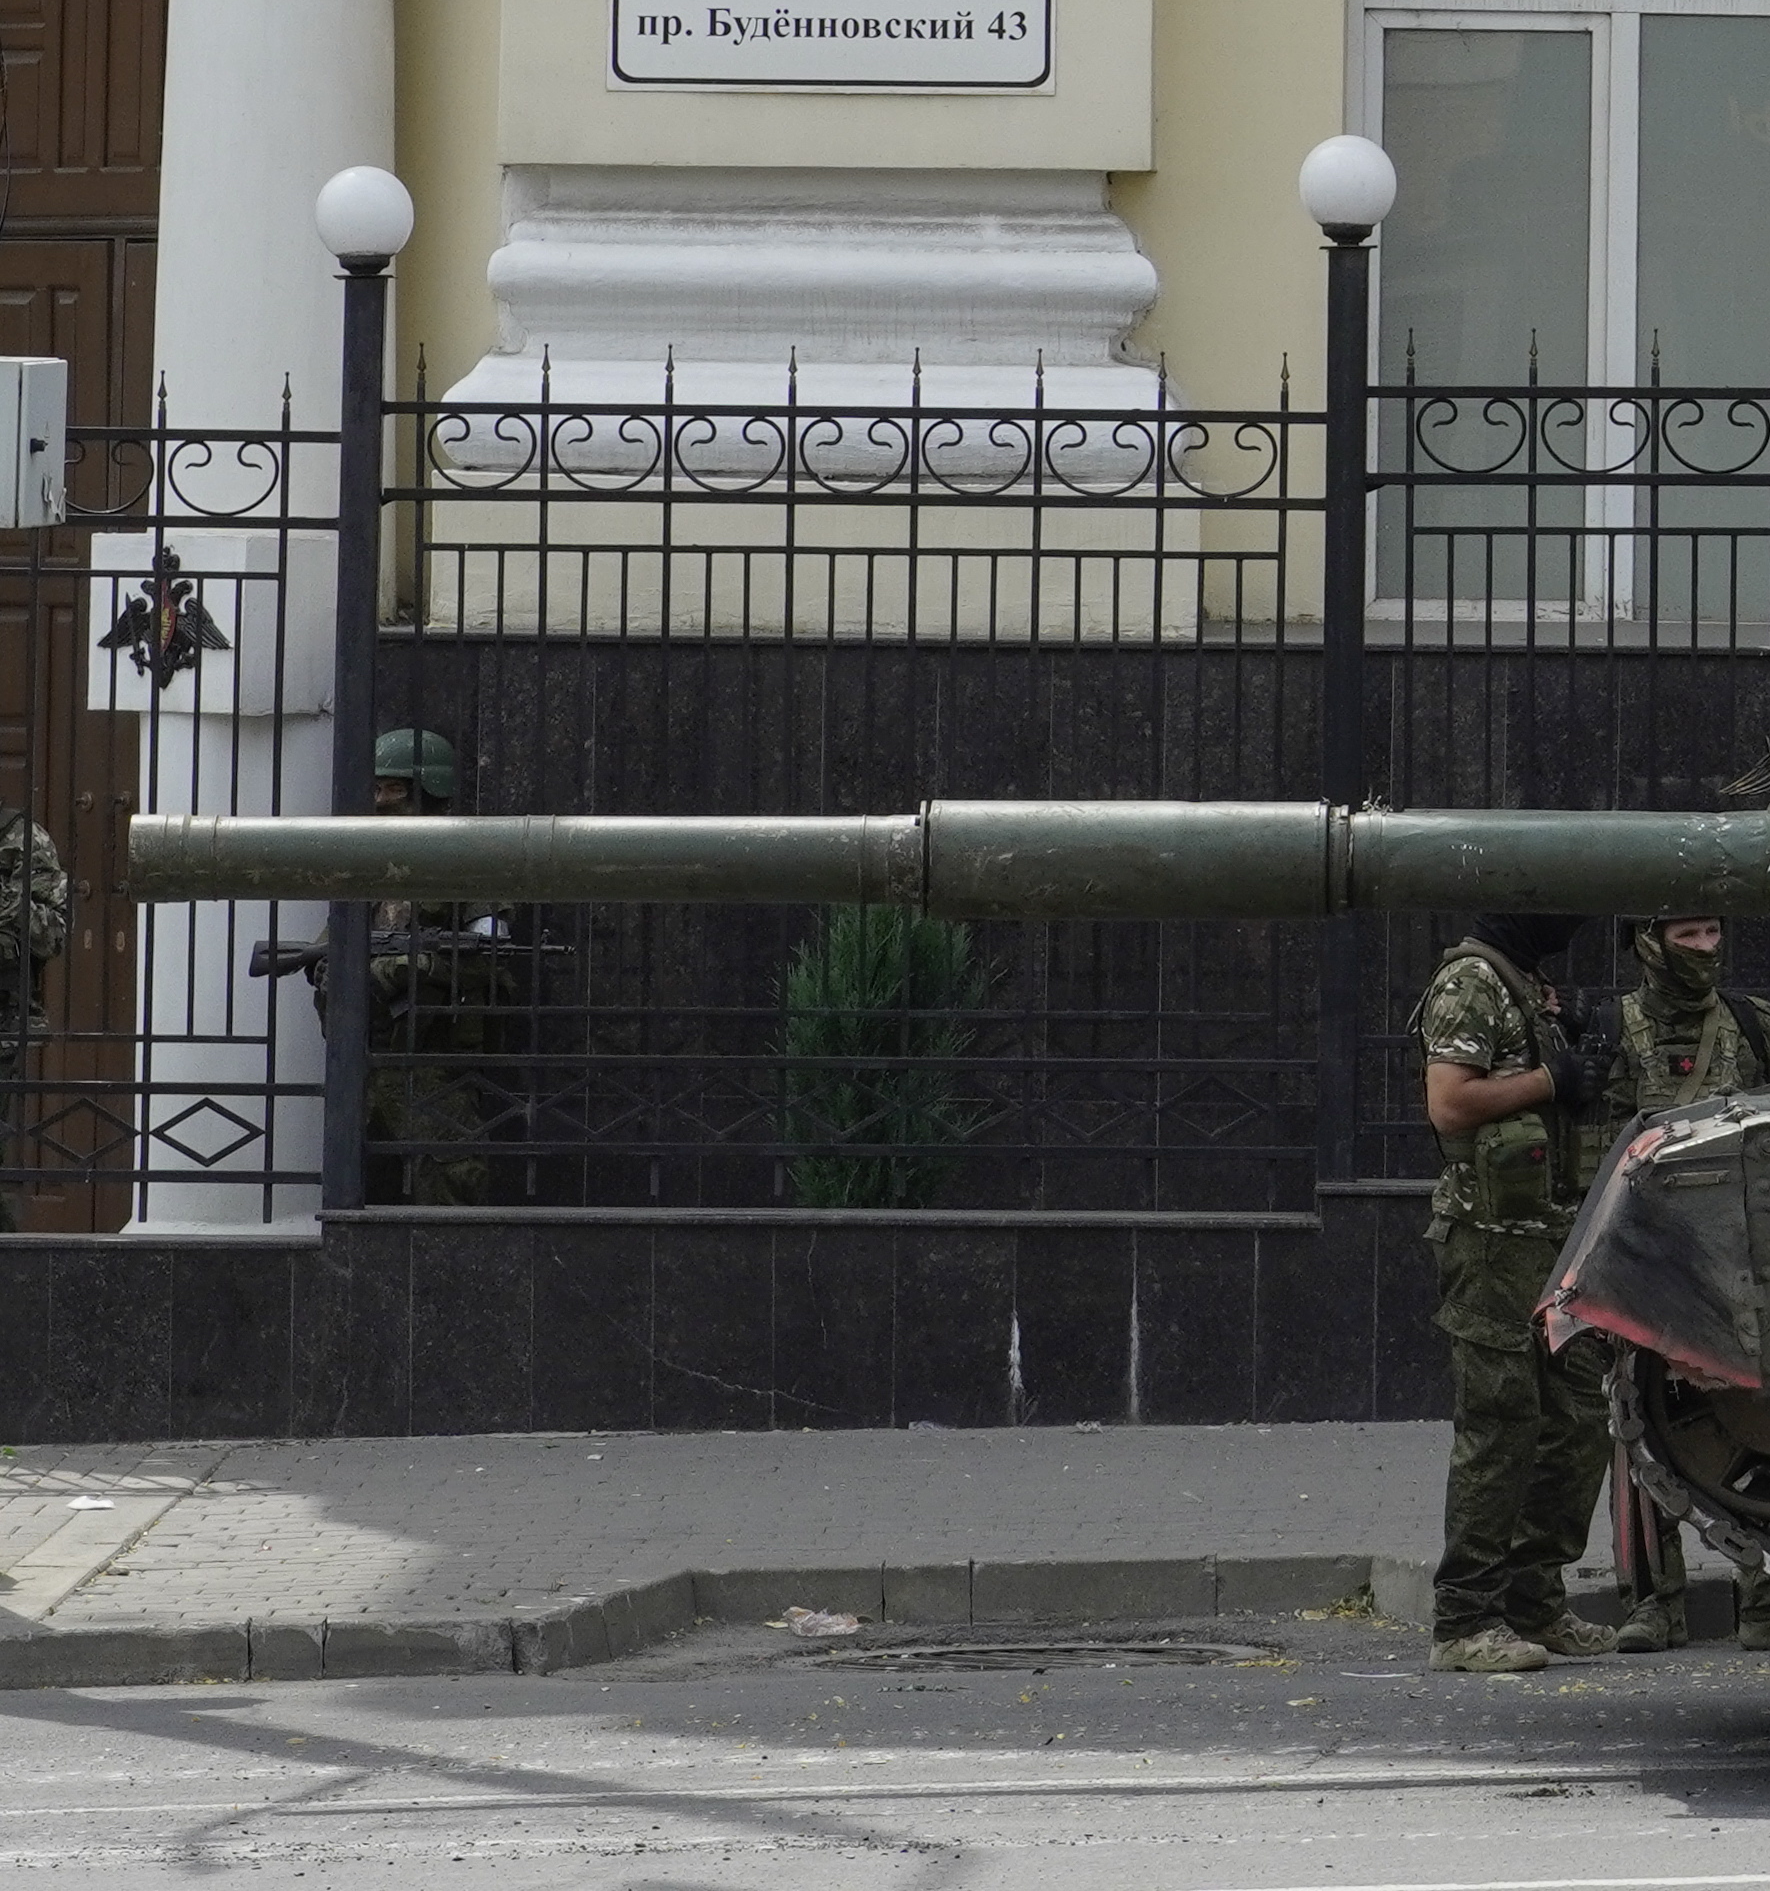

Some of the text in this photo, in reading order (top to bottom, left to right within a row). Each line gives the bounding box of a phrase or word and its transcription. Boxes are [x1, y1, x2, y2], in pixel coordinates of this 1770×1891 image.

[636, 7, 1028, 46] пр. Будённовский 43
